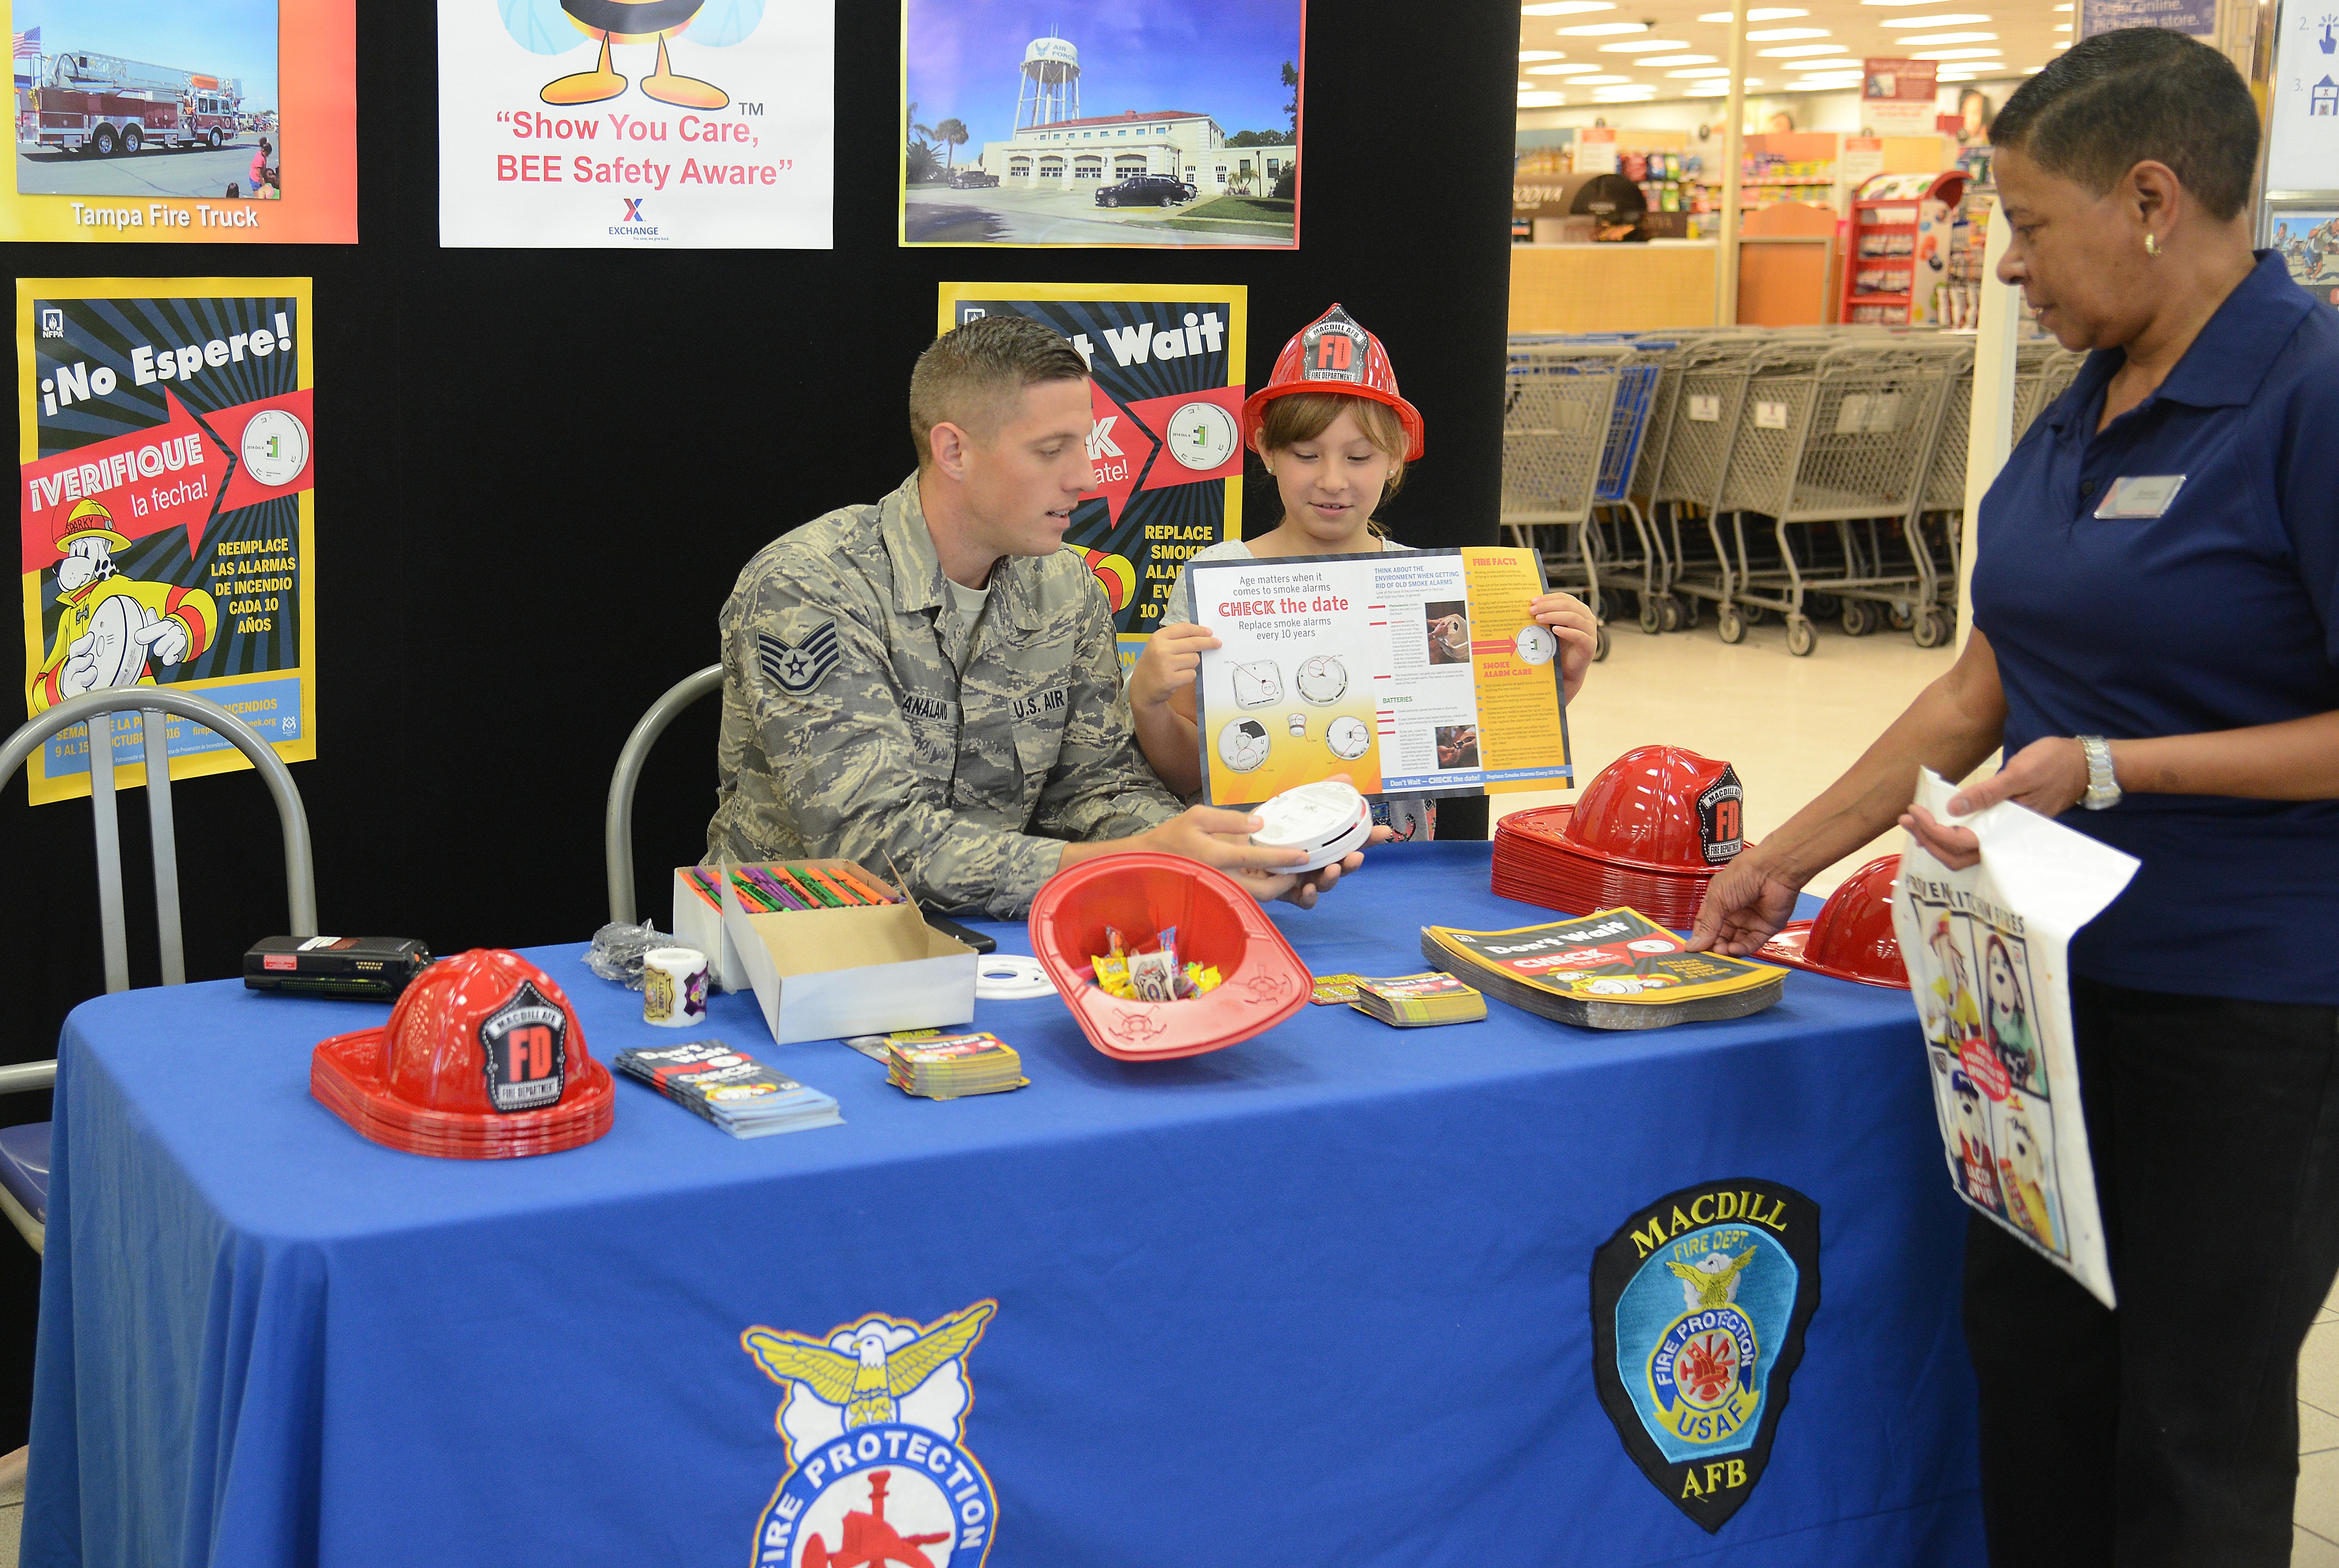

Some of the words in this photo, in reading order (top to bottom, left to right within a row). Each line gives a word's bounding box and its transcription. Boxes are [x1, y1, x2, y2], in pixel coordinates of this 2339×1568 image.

[2299, 17, 2309, 30] 2.
[1052, 51, 1075, 62] FORCE
[2294, 78, 2303, 92] 3.
[739, 102, 764, 116] TM
[497, 110, 599, 140] “Show
[608, 114, 667, 141] You
[679, 116, 759, 148] Care,
[497, 155, 562, 183] BEE
[573, 156, 671, 191] Safety
[679, 157, 793, 186] Aware”
[71, 202, 143, 232] Tampa
[149, 204, 191, 227] Fire
[197, 205, 259, 228] Truck
[609, 227, 659, 235] EXCHANGE
[1103, 312, 1225, 367] Wait
[1313, 324, 1345, 335] MACDILL
[1346, 327, 1359, 338] AFB
[1317, 335, 1352, 370] FD
[41, 361, 117, 417] ¡No
[130, 312, 292, 387] Espere!
[1322, 373, 1352, 382] DEPARTMENT
[29, 433, 204, 512] ¡VERIFIQUE
[1095, 460, 1130, 484] ate!
[131, 495, 149, 518] la
[151, 474, 208, 511] fecha!
[64, 516, 94, 535] SPARKY
[1145, 525, 1213, 540] REPLACE
[218, 539, 289, 556] REEMPLACE
[211, 561, 235, 577] LAS
[237, 557, 296, 576] ALARMAS
[215, 581, 232, 597] DE
[234, 579, 292, 595] INCENDIO
[1240, 576, 1255, 586] Age
[1258, 574, 1290, 584] matters
[1292, 573, 1314, 583] when
[1316, 572, 1323, 581] it
[1233, 587, 1260, 597] comes
[1263, 586, 1271, 595] to
[1273, 585, 1300, 594] smoke
[1302, 583, 1331, 593] alarms
[228, 599, 261, 616] CADA
[264, 598, 279, 611] 10
[1140, 604, 1158, 618] 10
[1218, 600, 1276, 617] CHECK
[1280, 598, 1307, 614] the
[1312, 596, 1349, 612] date
[237, 617, 272, 634] AÑOS
[1239, 621, 1272, 631] Replace
[1274, 618, 1301, 629] smoke
[1303, 617, 1331, 627] alarms
[1257, 631, 1279, 642] every
[1282, 630, 1291, 639] 10
[1293, 630, 1316, 640] years
[903, 695, 948, 720] ANALAND
[1013, 697, 1041, 718] U.S.
[1044, 690, 1065, 711] AIR
[118, 718, 131, 730] LA
[55, 746, 61, 757] 9
[64, 744, 76, 756] AL
[79, 741, 88, 754] 15
[1428, 776, 1453, 784] CHECK
[1709, 788, 1734, 803] MACDILL
[1716, 800, 1739, 842] FD
[1711, 846, 1720, 855] FIRE
[1484, 938, 1564, 954] Don't
[1558, 921, 1630, 942] Wait
[1513, 949, 1614, 968] CHECK
[1594, 954, 1624, 964] date!
[509, 1026, 552, 1083] FD
[670, 1047, 731, 1064] Wait
[503, 1088, 515, 1098] FIRE
[1630, 1191, 1787, 1258] MACDILL
[1673, 1234, 1709, 1261] FIRE
[1711, 1230, 1750, 1250] DEPT.
[1655, 1339, 1679, 1386] FIRE
[1676, 1311, 1753, 1368] PROTECTION
[1677, 1397, 1744, 1439] USAF
[1681, 1458, 1747, 1499] AFB
[803, 1430, 986, 1550] PROTECTION
[761, 1492, 805, 1568] IRE
